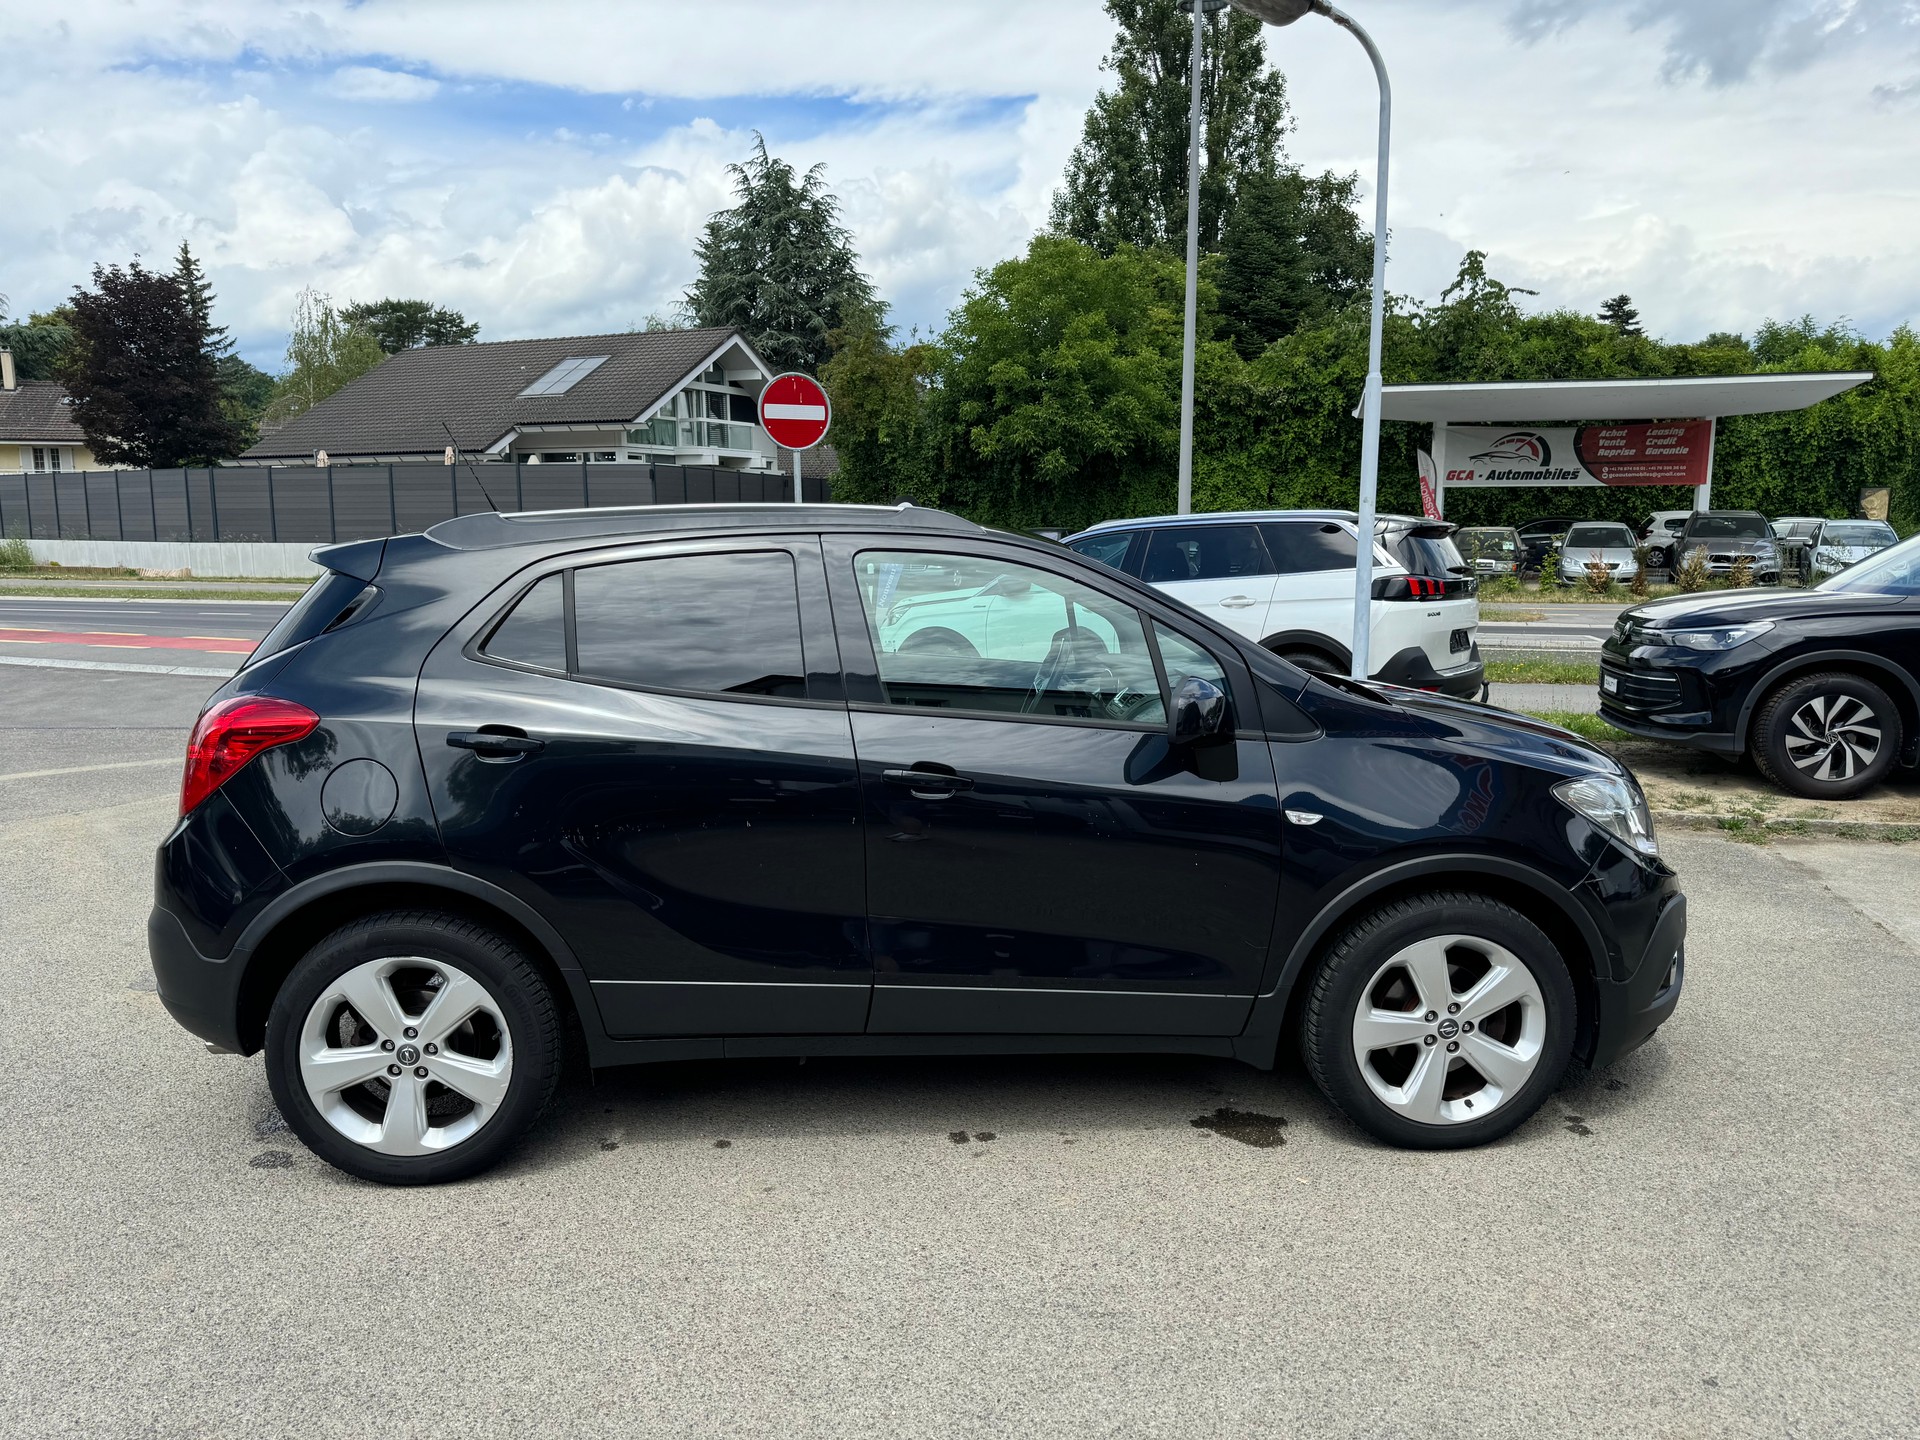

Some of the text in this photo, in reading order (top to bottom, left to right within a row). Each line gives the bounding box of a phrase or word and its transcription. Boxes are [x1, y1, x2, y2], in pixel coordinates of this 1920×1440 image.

[1599, 429, 1628, 437] Achat
[1646, 427, 1685, 437] Leasing
[1598, 438, 1626, 447] Vente
[1597, 447, 1636, 458] Reprise
[1645, 446, 1689, 455] Garantie
[1445, 469, 1475, 481] GCA
[1485, 468, 1581, 481] Automobiles
[878, 568, 897, 607] Nouveau
